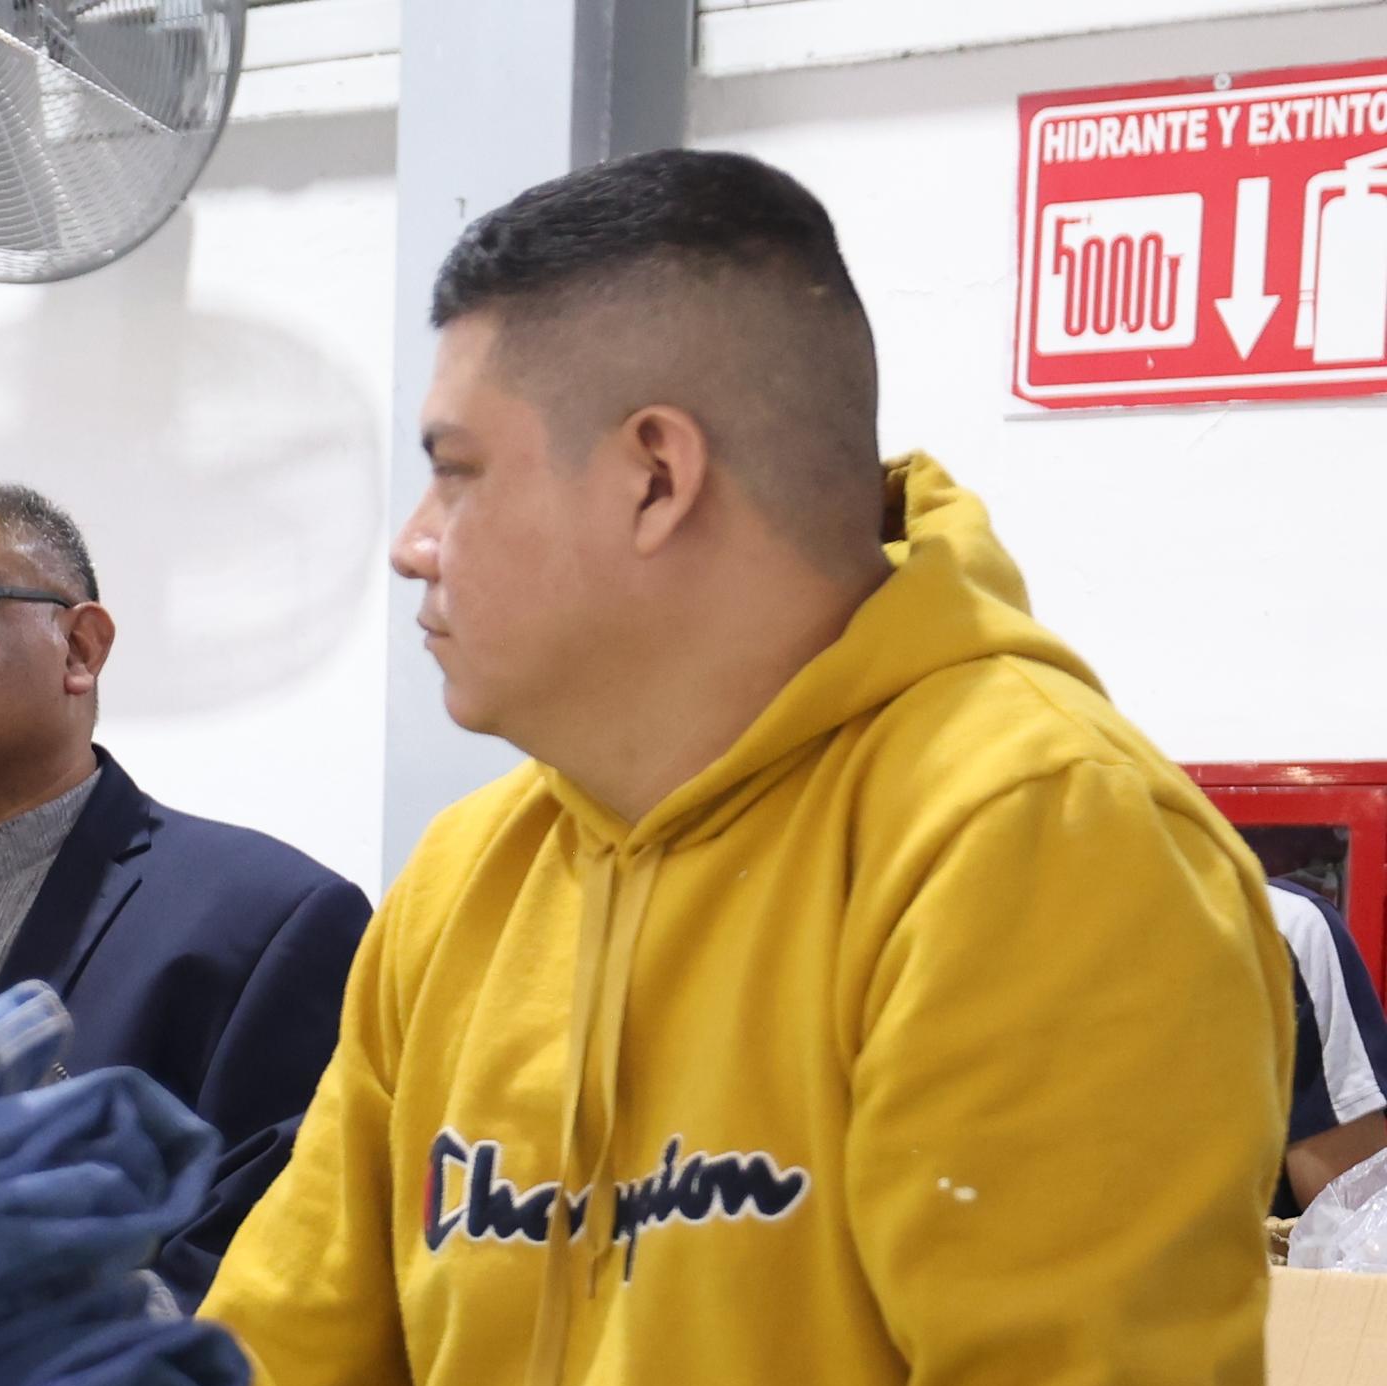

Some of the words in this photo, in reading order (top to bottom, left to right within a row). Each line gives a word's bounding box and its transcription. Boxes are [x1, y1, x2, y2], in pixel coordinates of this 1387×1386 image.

[1043, 108, 1209, 163] HIDRANTE
[1217, 104, 1242, 148] Y
[1247, 90, 1387, 146] EXTINTO
